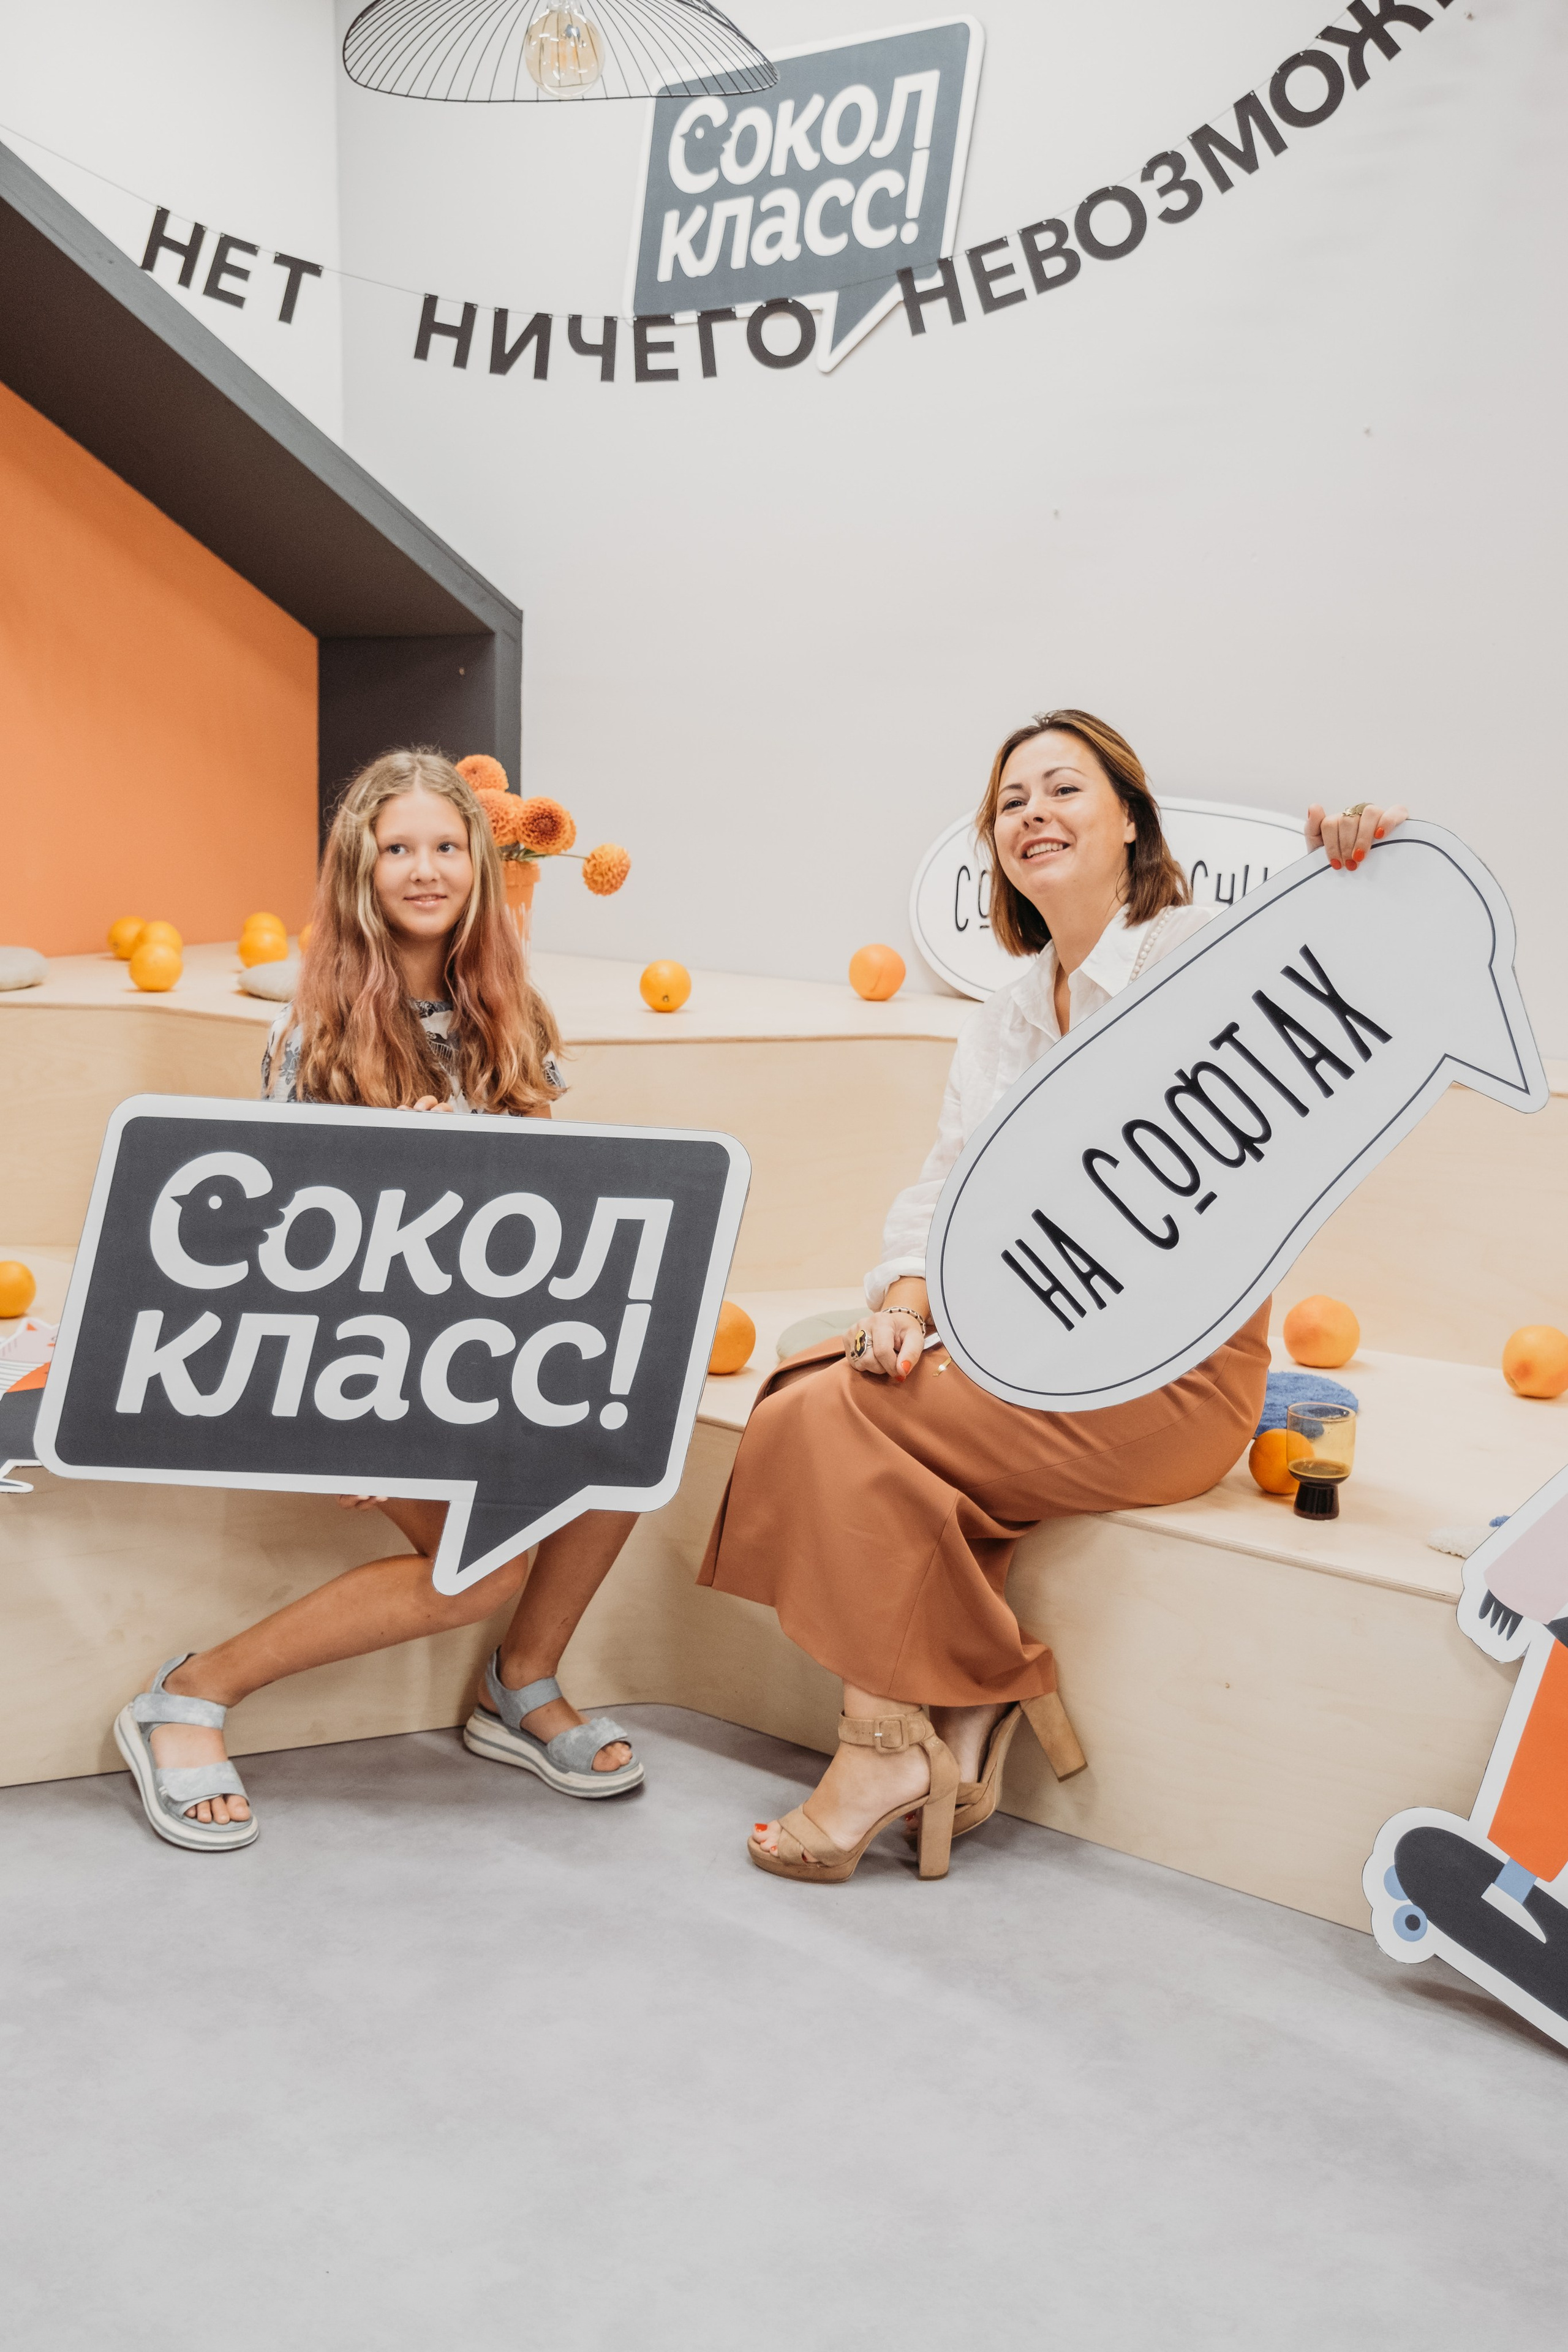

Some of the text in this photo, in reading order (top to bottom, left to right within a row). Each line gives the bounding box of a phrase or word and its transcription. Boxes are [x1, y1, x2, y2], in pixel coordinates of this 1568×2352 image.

[139, 0, 1454, 383] НЕТ НИЧЕГО НЕВОЗМОЖ
[1001, 1208, 1125, 1332] НА
